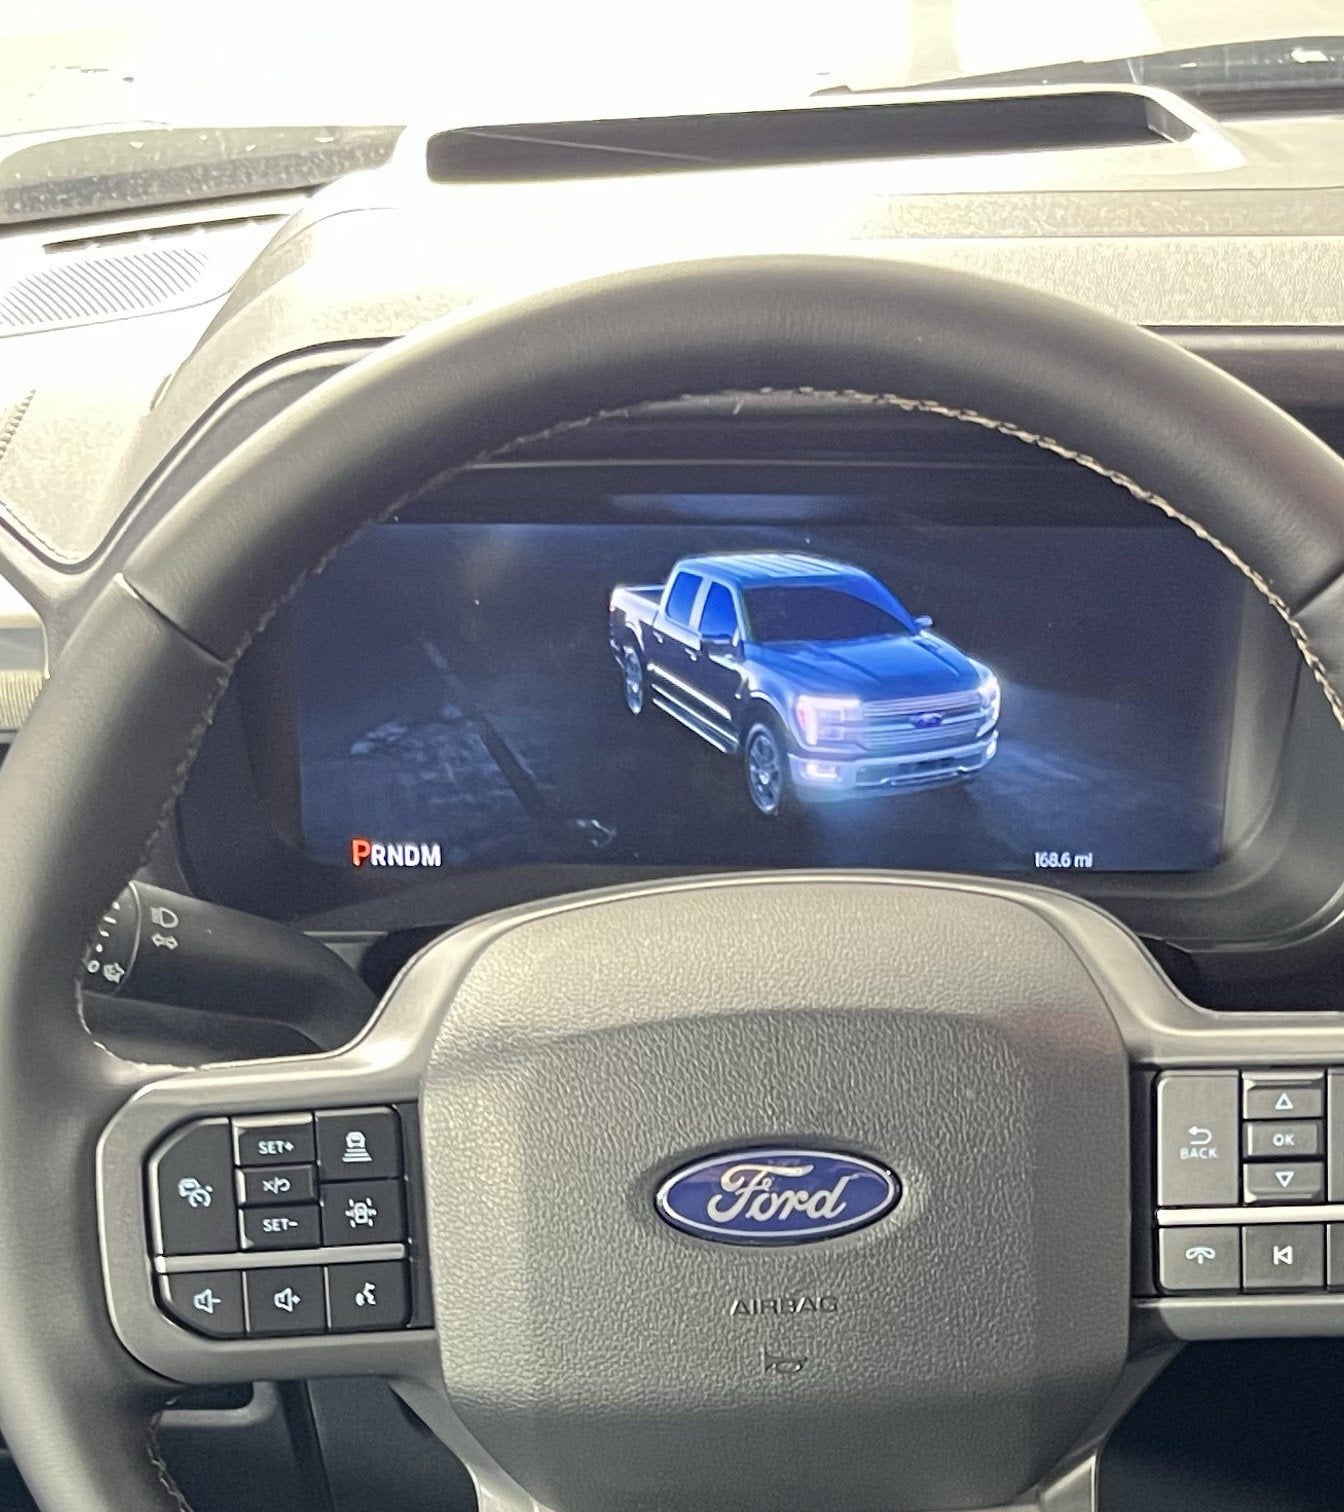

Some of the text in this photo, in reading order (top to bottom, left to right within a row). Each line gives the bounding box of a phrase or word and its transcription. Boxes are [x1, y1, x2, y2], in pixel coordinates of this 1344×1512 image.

[1035, 852, 1071, 867] 168.6
[258, 1140, 294, 1155] SET+
[1273, 1134, 1294, 1146] OK
[1180, 1148, 1217, 1160] BACK
[707, 1163, 860, 1222] Ford
[263, 1219, 298, 1232] SET-
[729, 1297, 838, 1316] AIRBAG
